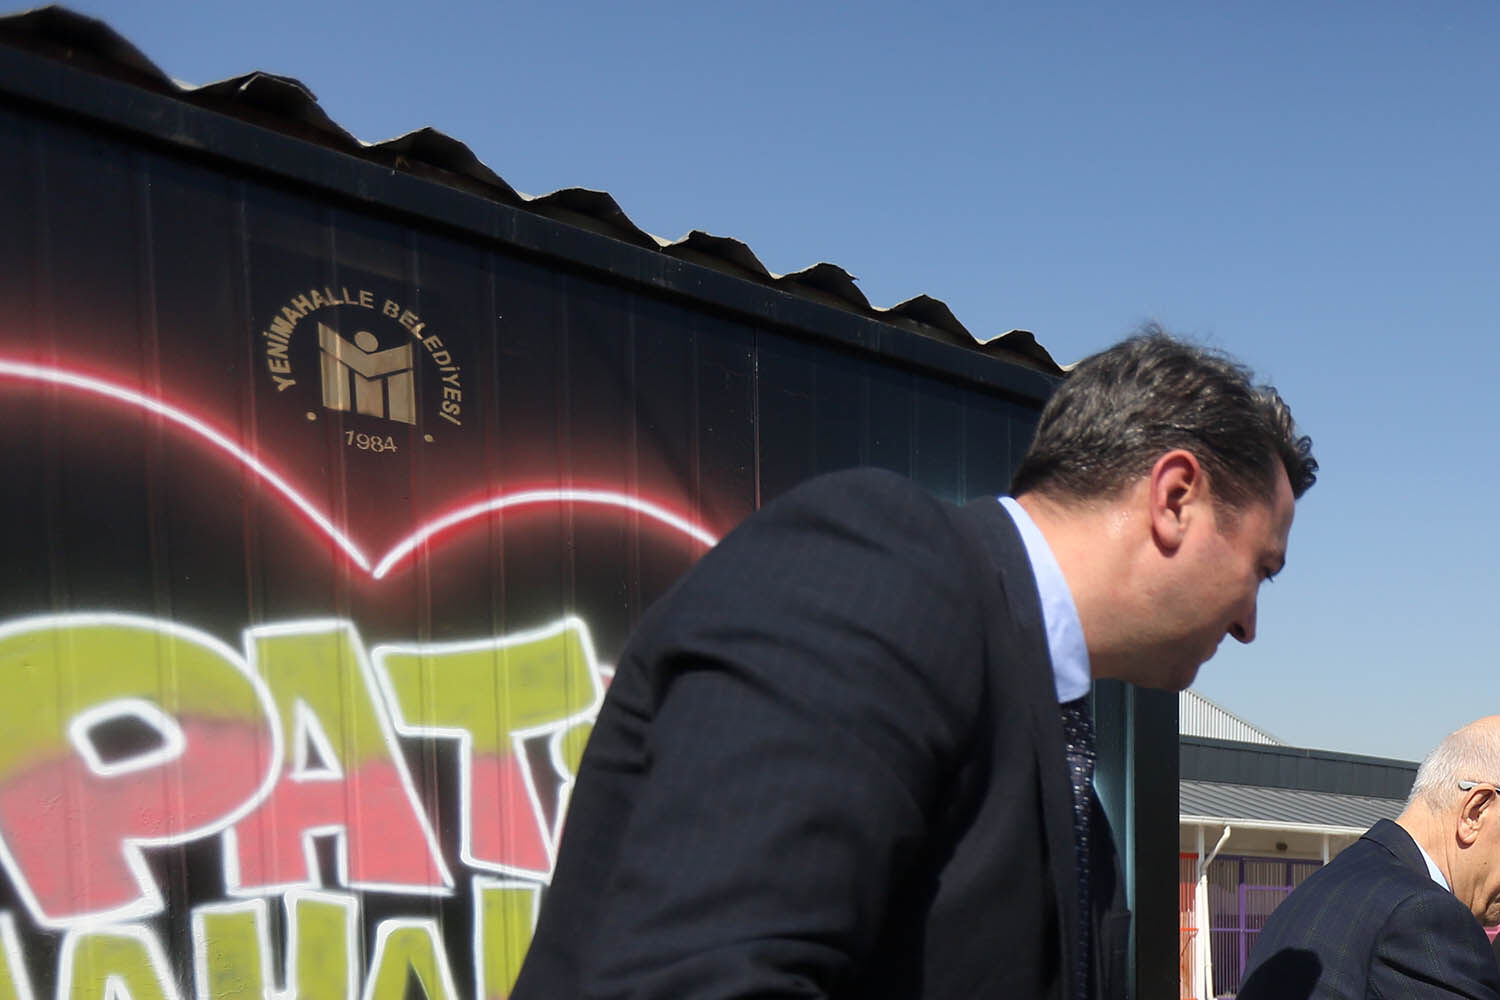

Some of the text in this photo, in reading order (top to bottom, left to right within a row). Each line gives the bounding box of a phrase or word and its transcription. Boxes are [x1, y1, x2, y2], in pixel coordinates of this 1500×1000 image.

[262, 287, 374, 392] YENİMAHALLE
[345, 430, 398, 453] 1984
[0, 612, 607, 929] PAT
